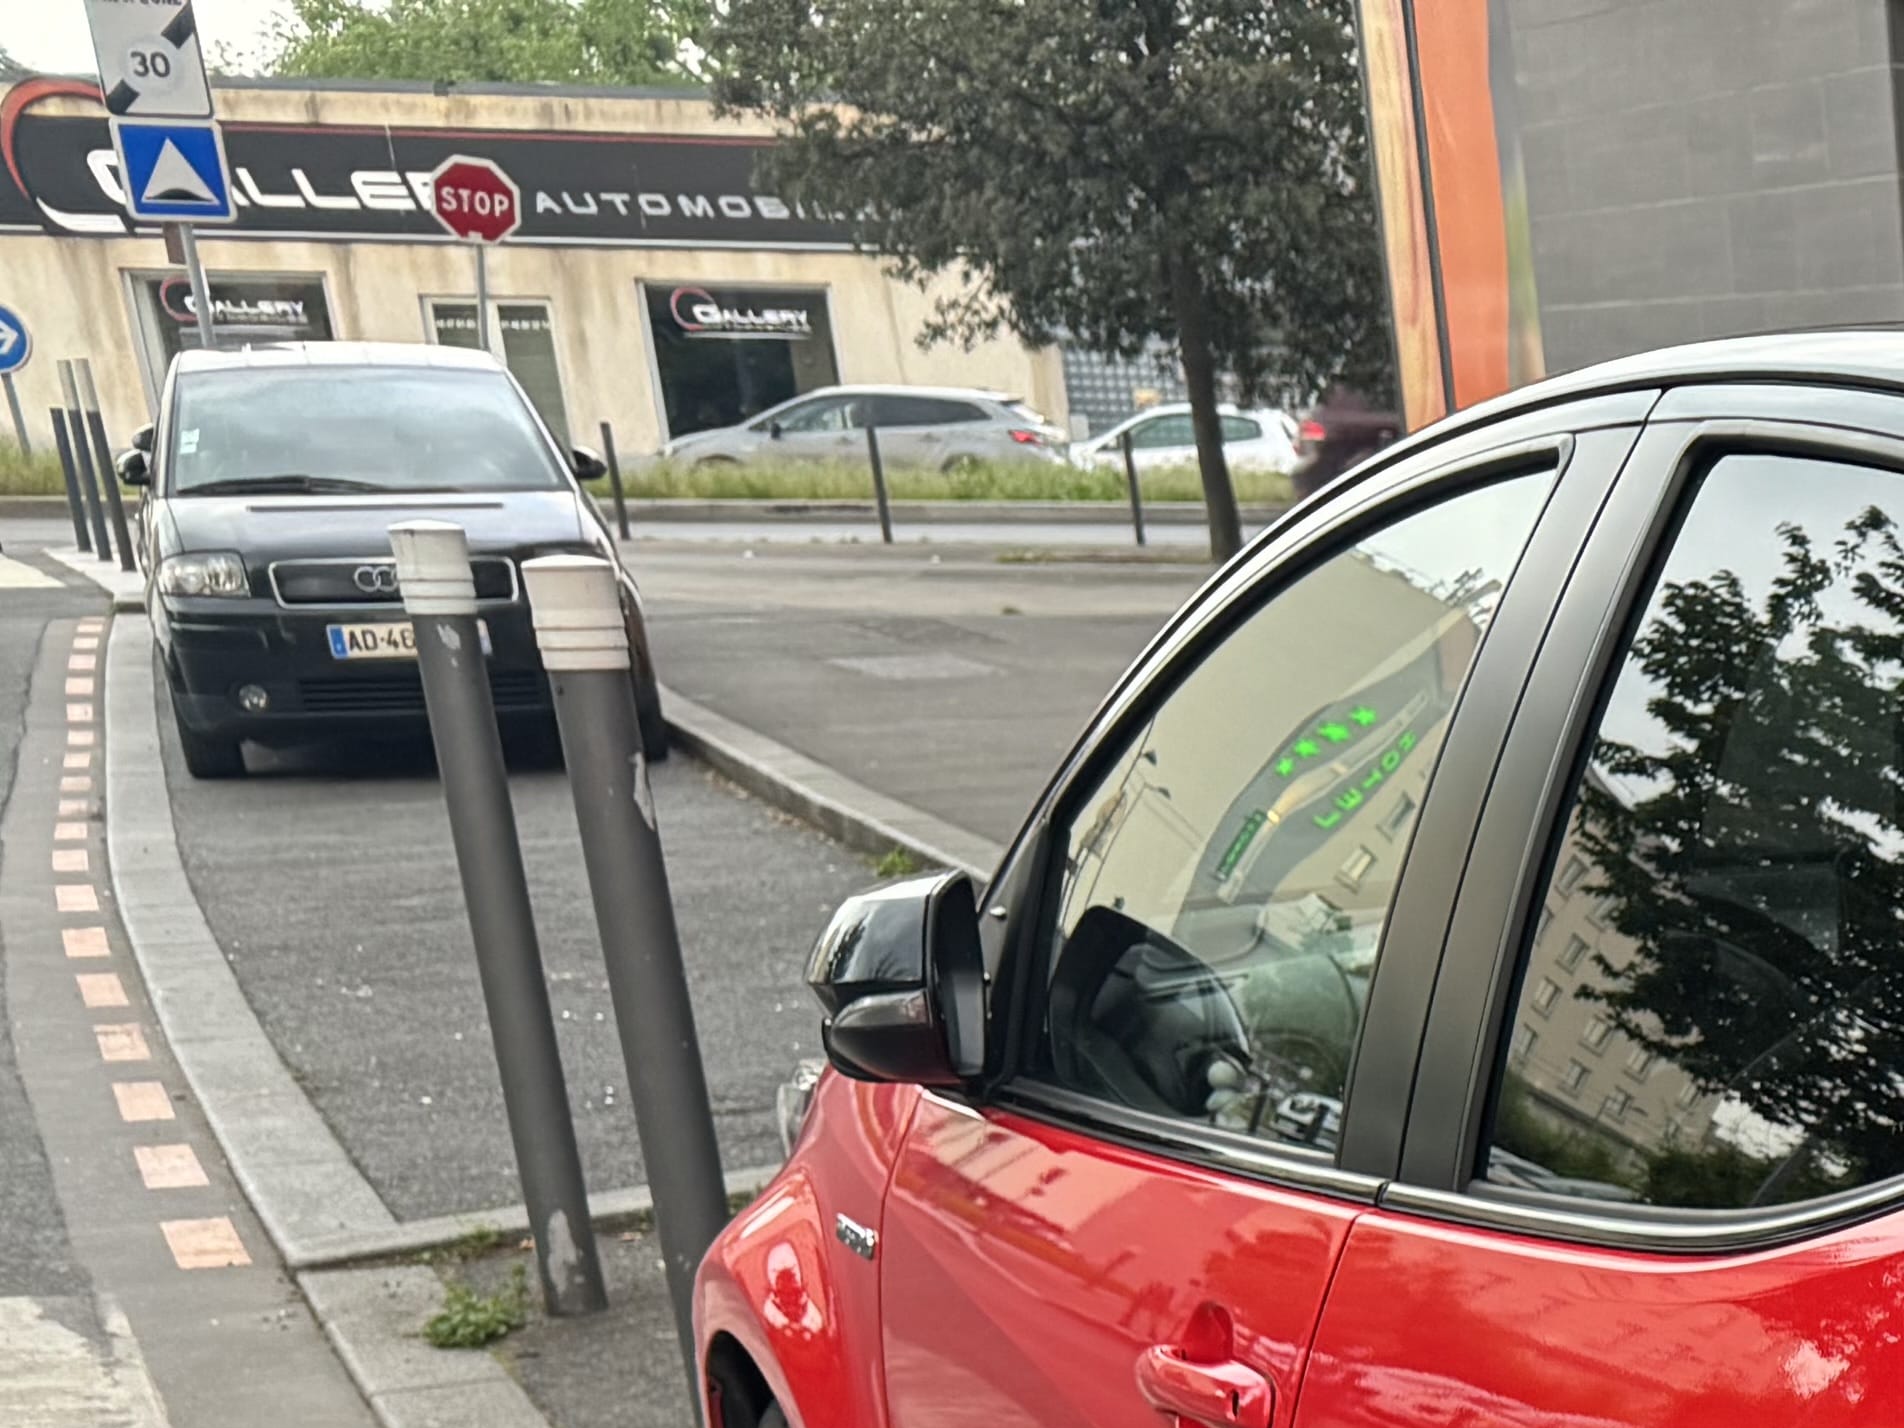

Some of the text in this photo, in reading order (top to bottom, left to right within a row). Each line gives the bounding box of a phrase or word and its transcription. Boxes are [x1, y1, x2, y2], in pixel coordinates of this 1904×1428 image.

[130, 51, 171, 78] 30
[441, 186, 508, 217] STOP
[692, 303, 807, 325] GALLERY
